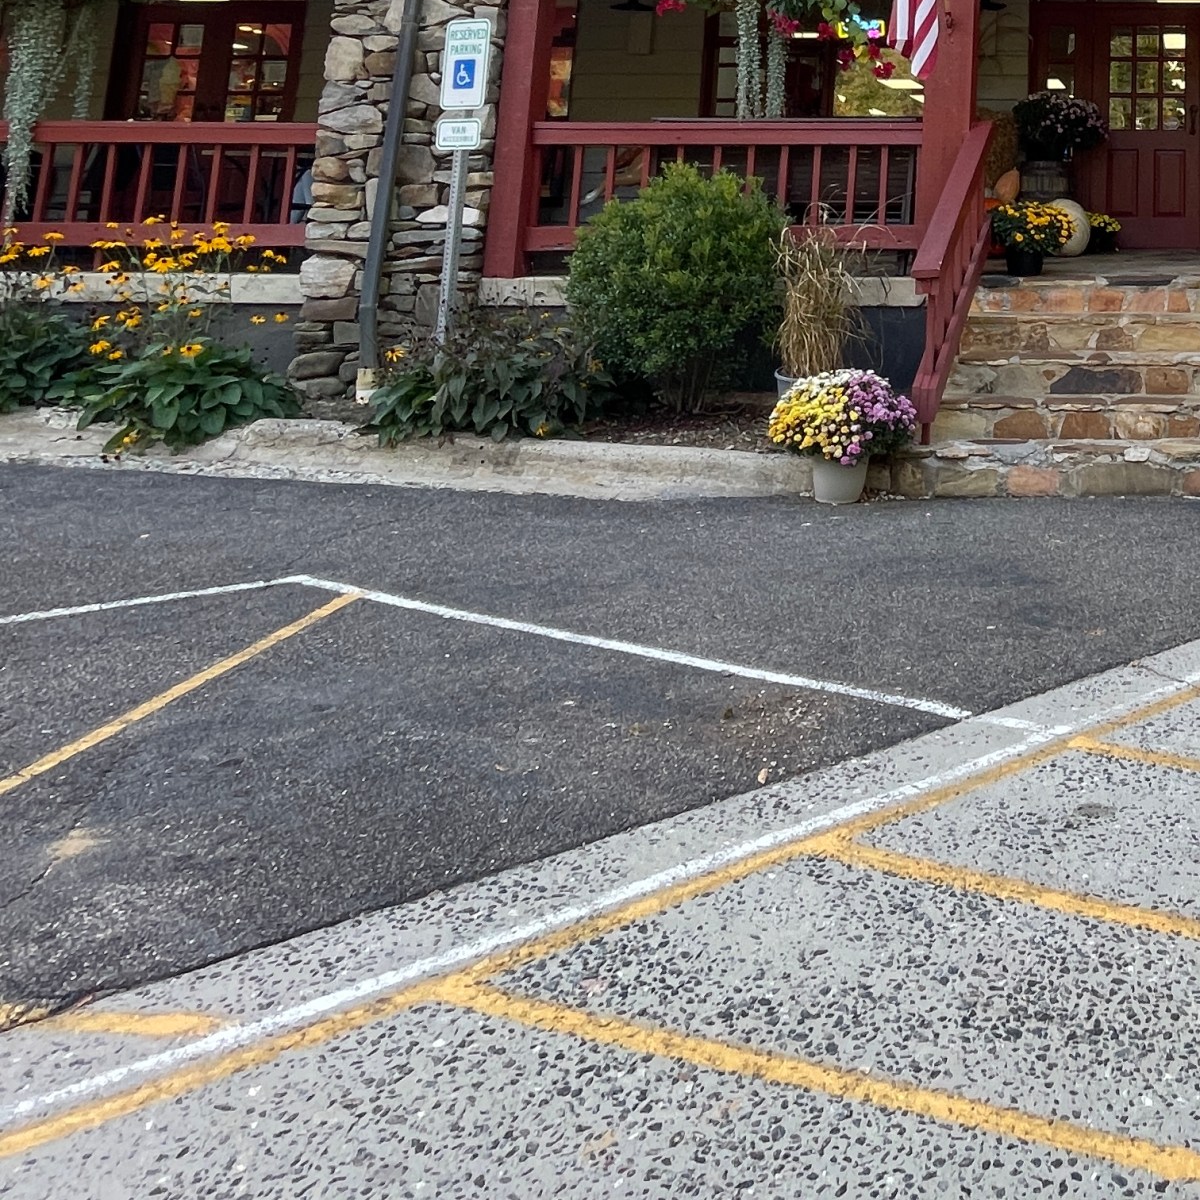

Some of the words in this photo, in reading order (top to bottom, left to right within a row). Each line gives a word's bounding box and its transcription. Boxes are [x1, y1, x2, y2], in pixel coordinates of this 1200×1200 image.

[450, 28, 487, 41] RESERVED
[449, 43, 482, 56] PARKING
[451, 125, 467, 135] VAN
